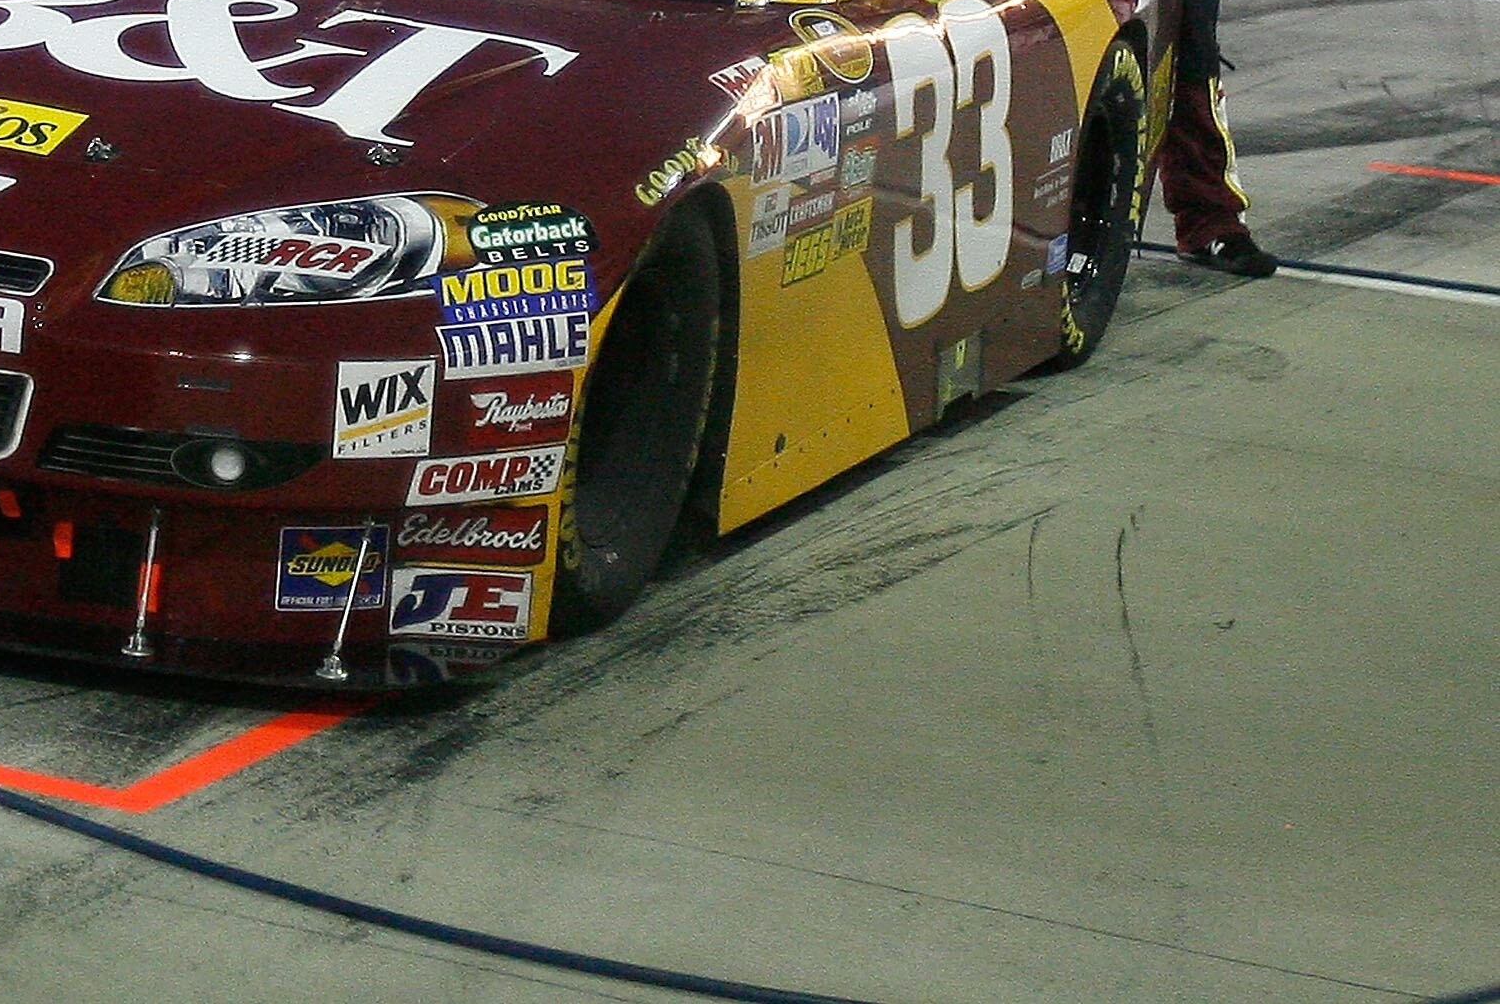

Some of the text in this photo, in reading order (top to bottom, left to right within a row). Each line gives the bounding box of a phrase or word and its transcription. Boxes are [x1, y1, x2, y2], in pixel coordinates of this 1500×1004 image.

[471, 216, 587, 250] Gatorback
[487, 239, 590, 263] BELTS
[266, 239, 373, 273] RCR
[441, 259, 587, 307] MOOG
[455, 294, 589, 322] CHASSIS PARTS
[443, 313, 589, 368] MAHLE
[340, 364, 431, 426] WIX
[338, 419, 429, 456] FILTERS
[418, 455, 532, 495] COMP
[493, 478, 544, 495] CAMS
[396, 513, 543, 550] Edelbrock
[391, 573, 528, 630] JE
[431, 622, 526, 638] PISTONS
